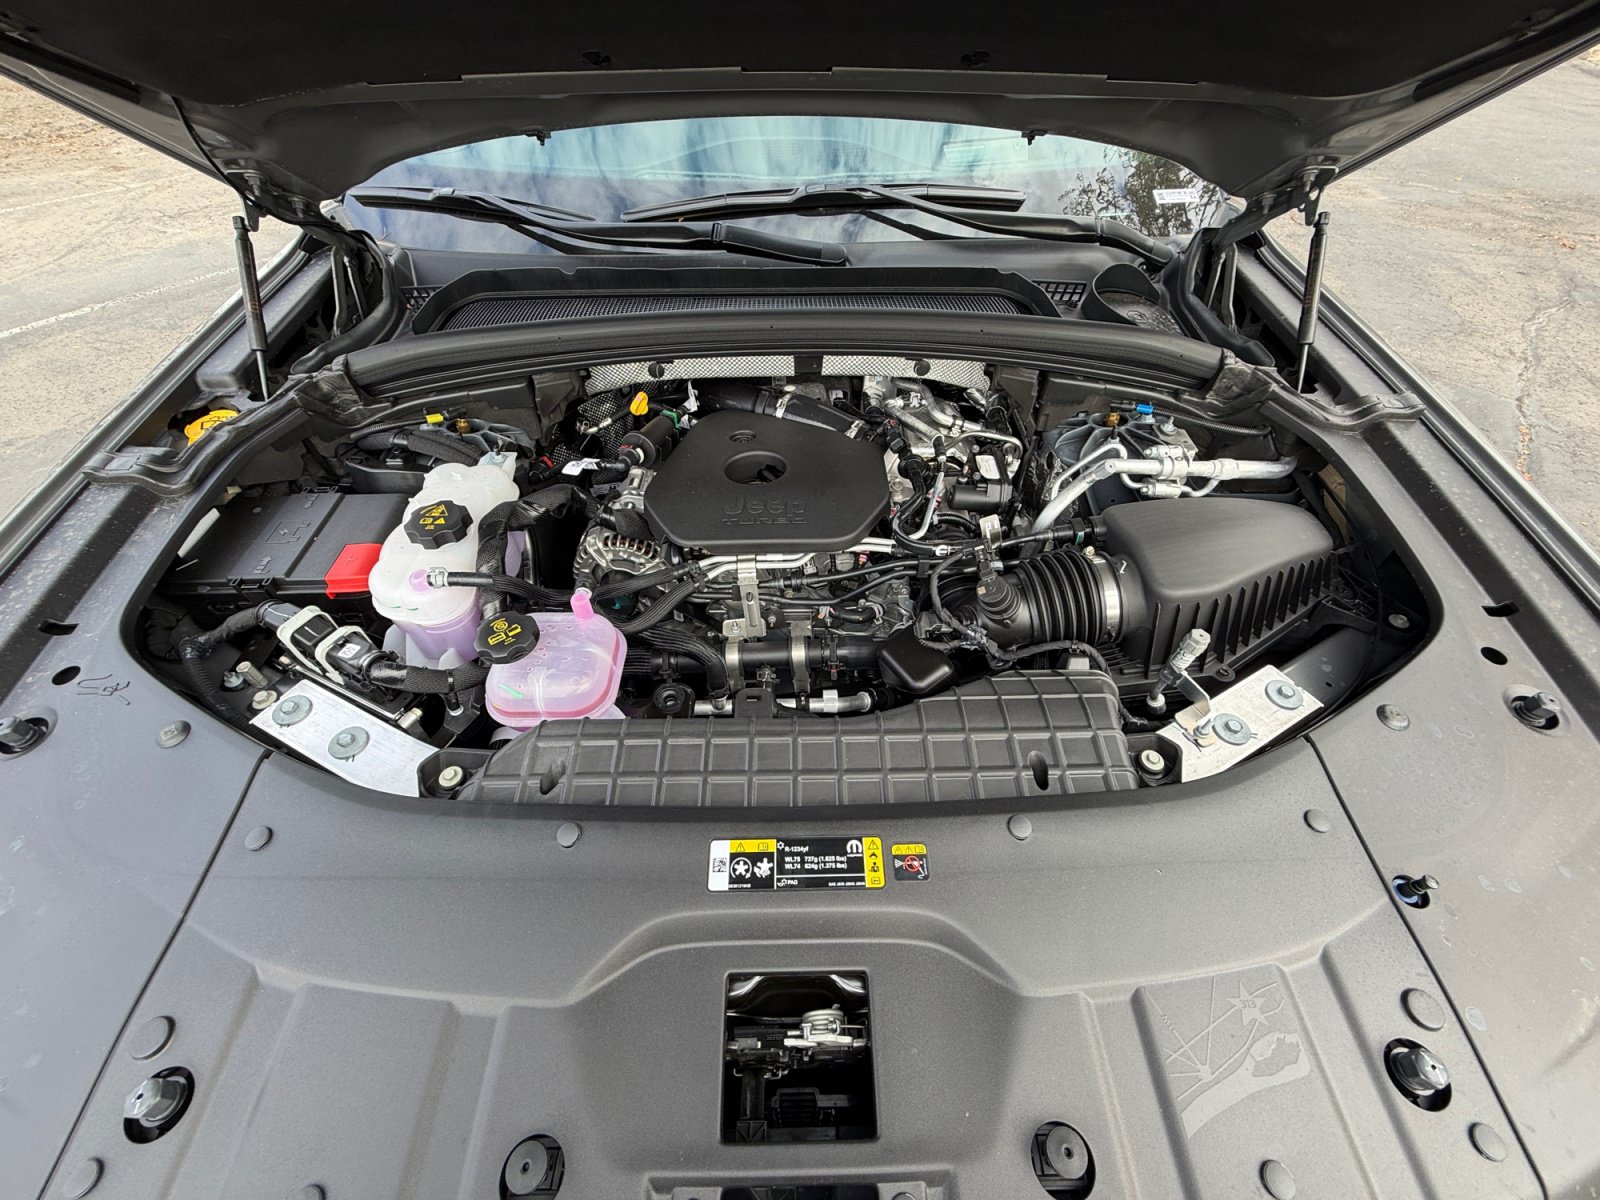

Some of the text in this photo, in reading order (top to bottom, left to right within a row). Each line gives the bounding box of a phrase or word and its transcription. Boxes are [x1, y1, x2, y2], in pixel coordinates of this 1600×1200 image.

[723, 496, 806, 517] Jeep
[721, 517, 808, 525] TURBO
[784, 845, 809, 853] R-1234yf
[1240, 999, 1257, 1009] 313
